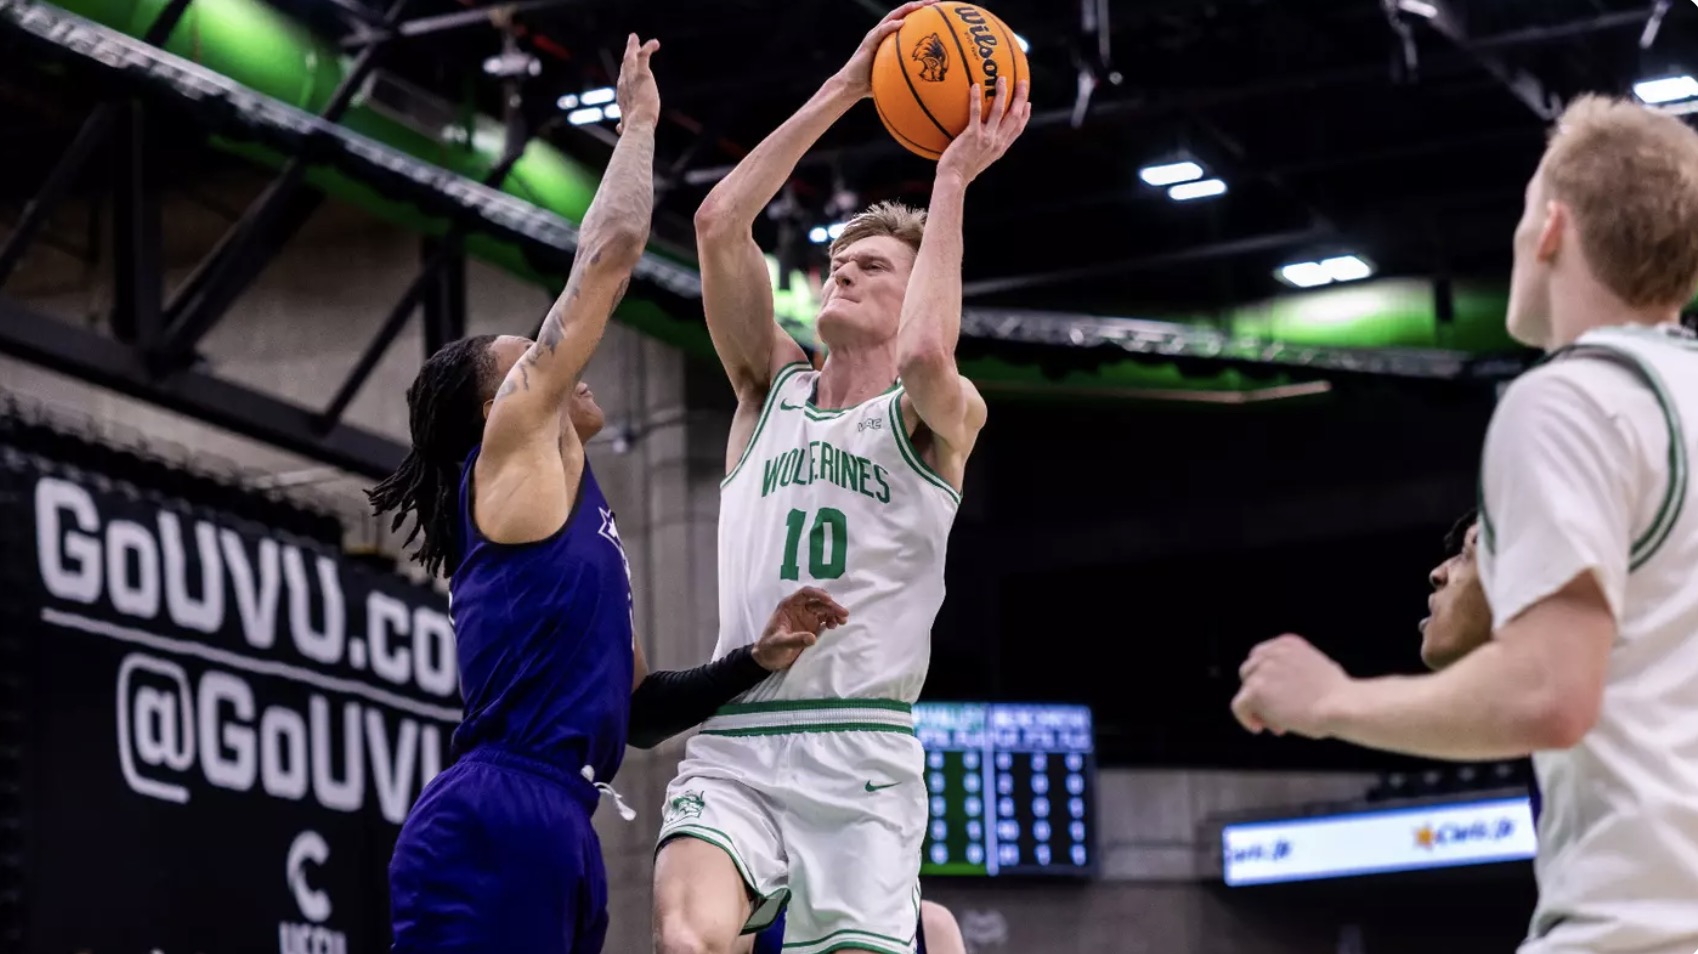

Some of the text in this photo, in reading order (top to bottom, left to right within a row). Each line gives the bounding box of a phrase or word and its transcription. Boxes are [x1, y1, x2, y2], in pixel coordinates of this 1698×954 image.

[954, 6, 1001, 98] Wilson
[761, 441, 890, 503] WOLERINES
[780, 507, 847, 581] 10
